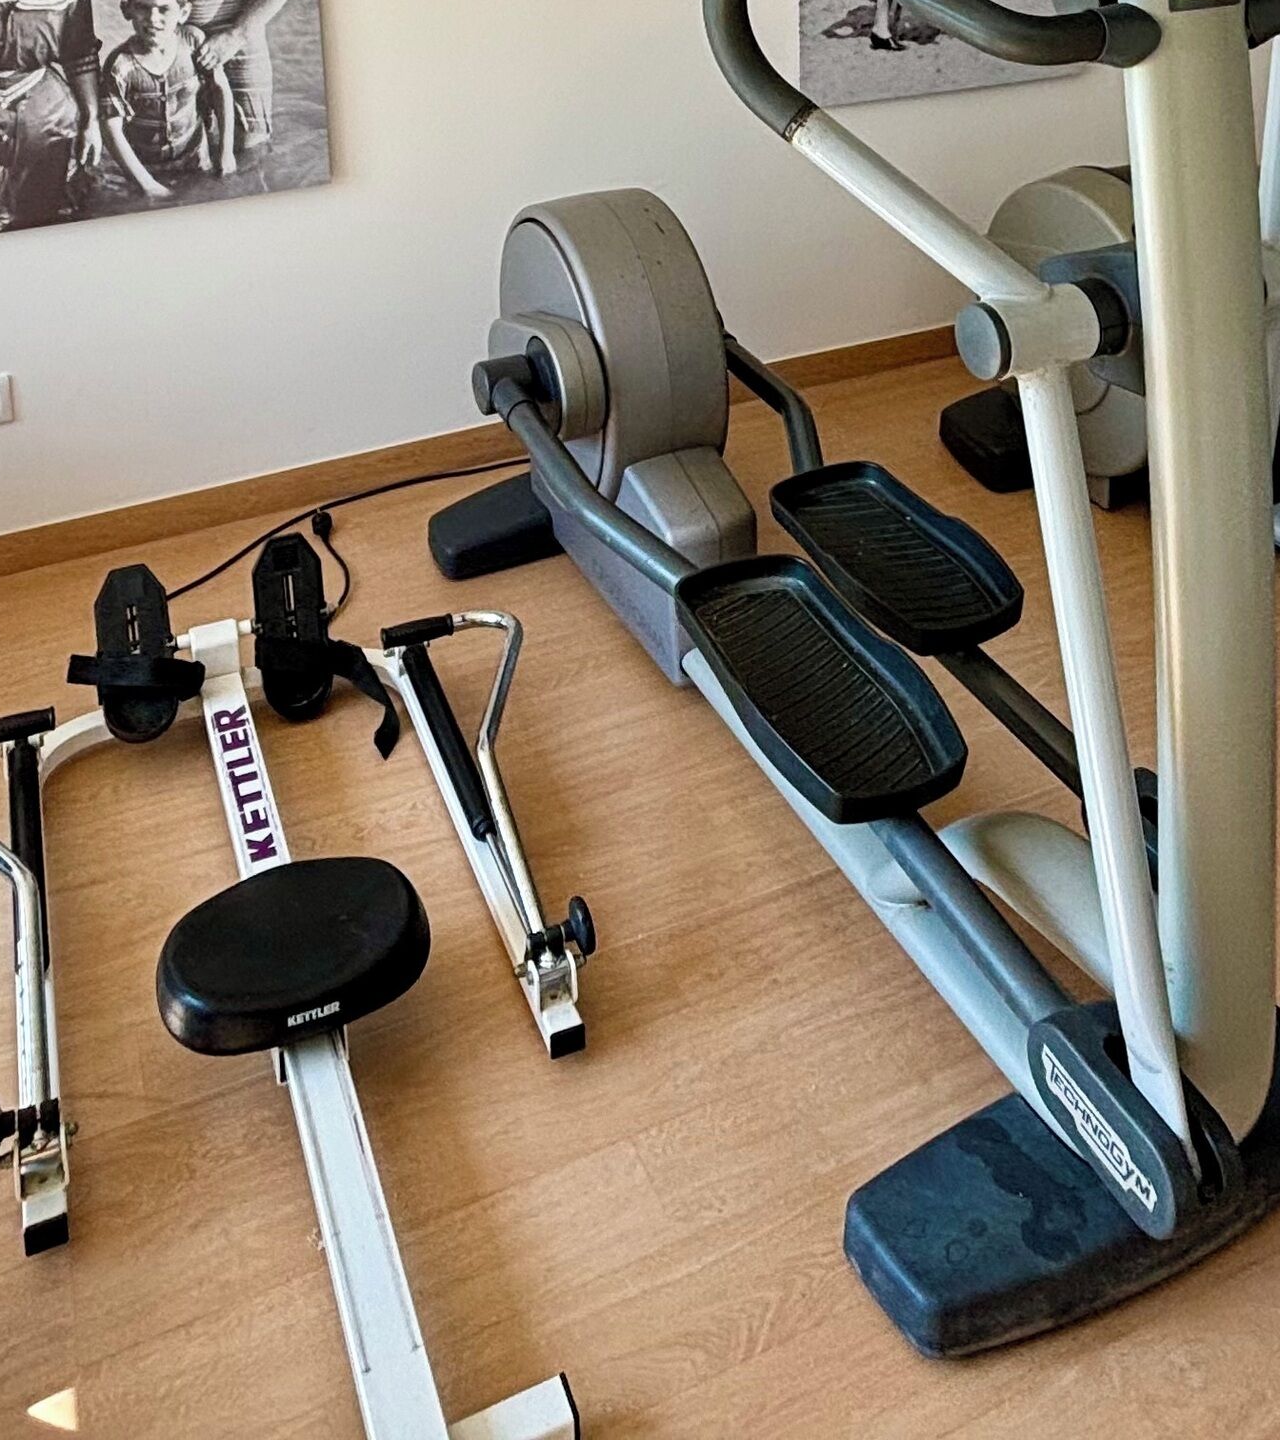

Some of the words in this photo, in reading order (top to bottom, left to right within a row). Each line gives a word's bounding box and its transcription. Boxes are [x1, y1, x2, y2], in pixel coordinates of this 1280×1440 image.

[213, 704, 278, 864] KETTLER
[287, 1000, 341, 1028] KETTLER
[1044, 1051, 1153, 1203] TECHNOGYM
